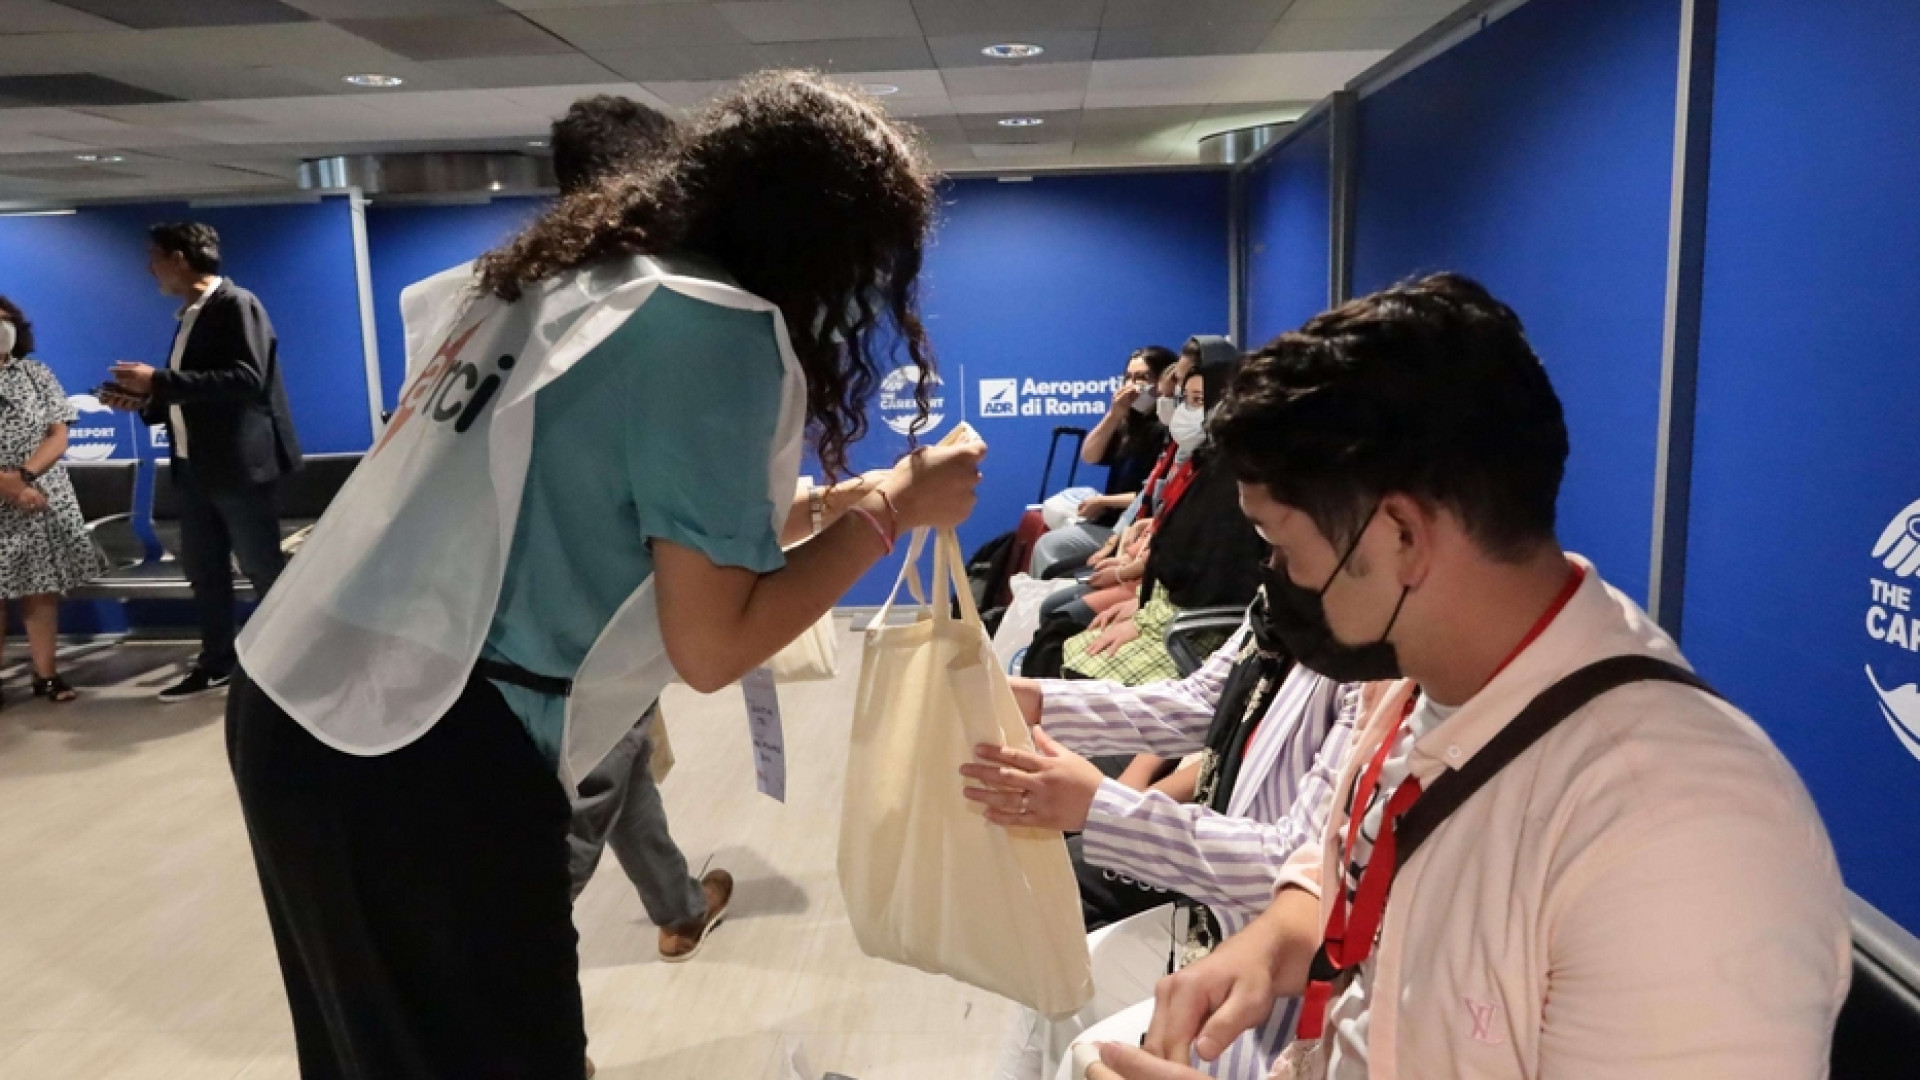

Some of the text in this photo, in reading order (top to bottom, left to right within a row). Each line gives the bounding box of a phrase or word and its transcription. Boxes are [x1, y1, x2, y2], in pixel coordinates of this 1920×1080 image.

[983, 402, 1014, 414] ADR
[1020, 398, 1105, 416] di Roma
[69, 427, 116, 438] REPORT
[1869, 577, 1912, 612] THE
